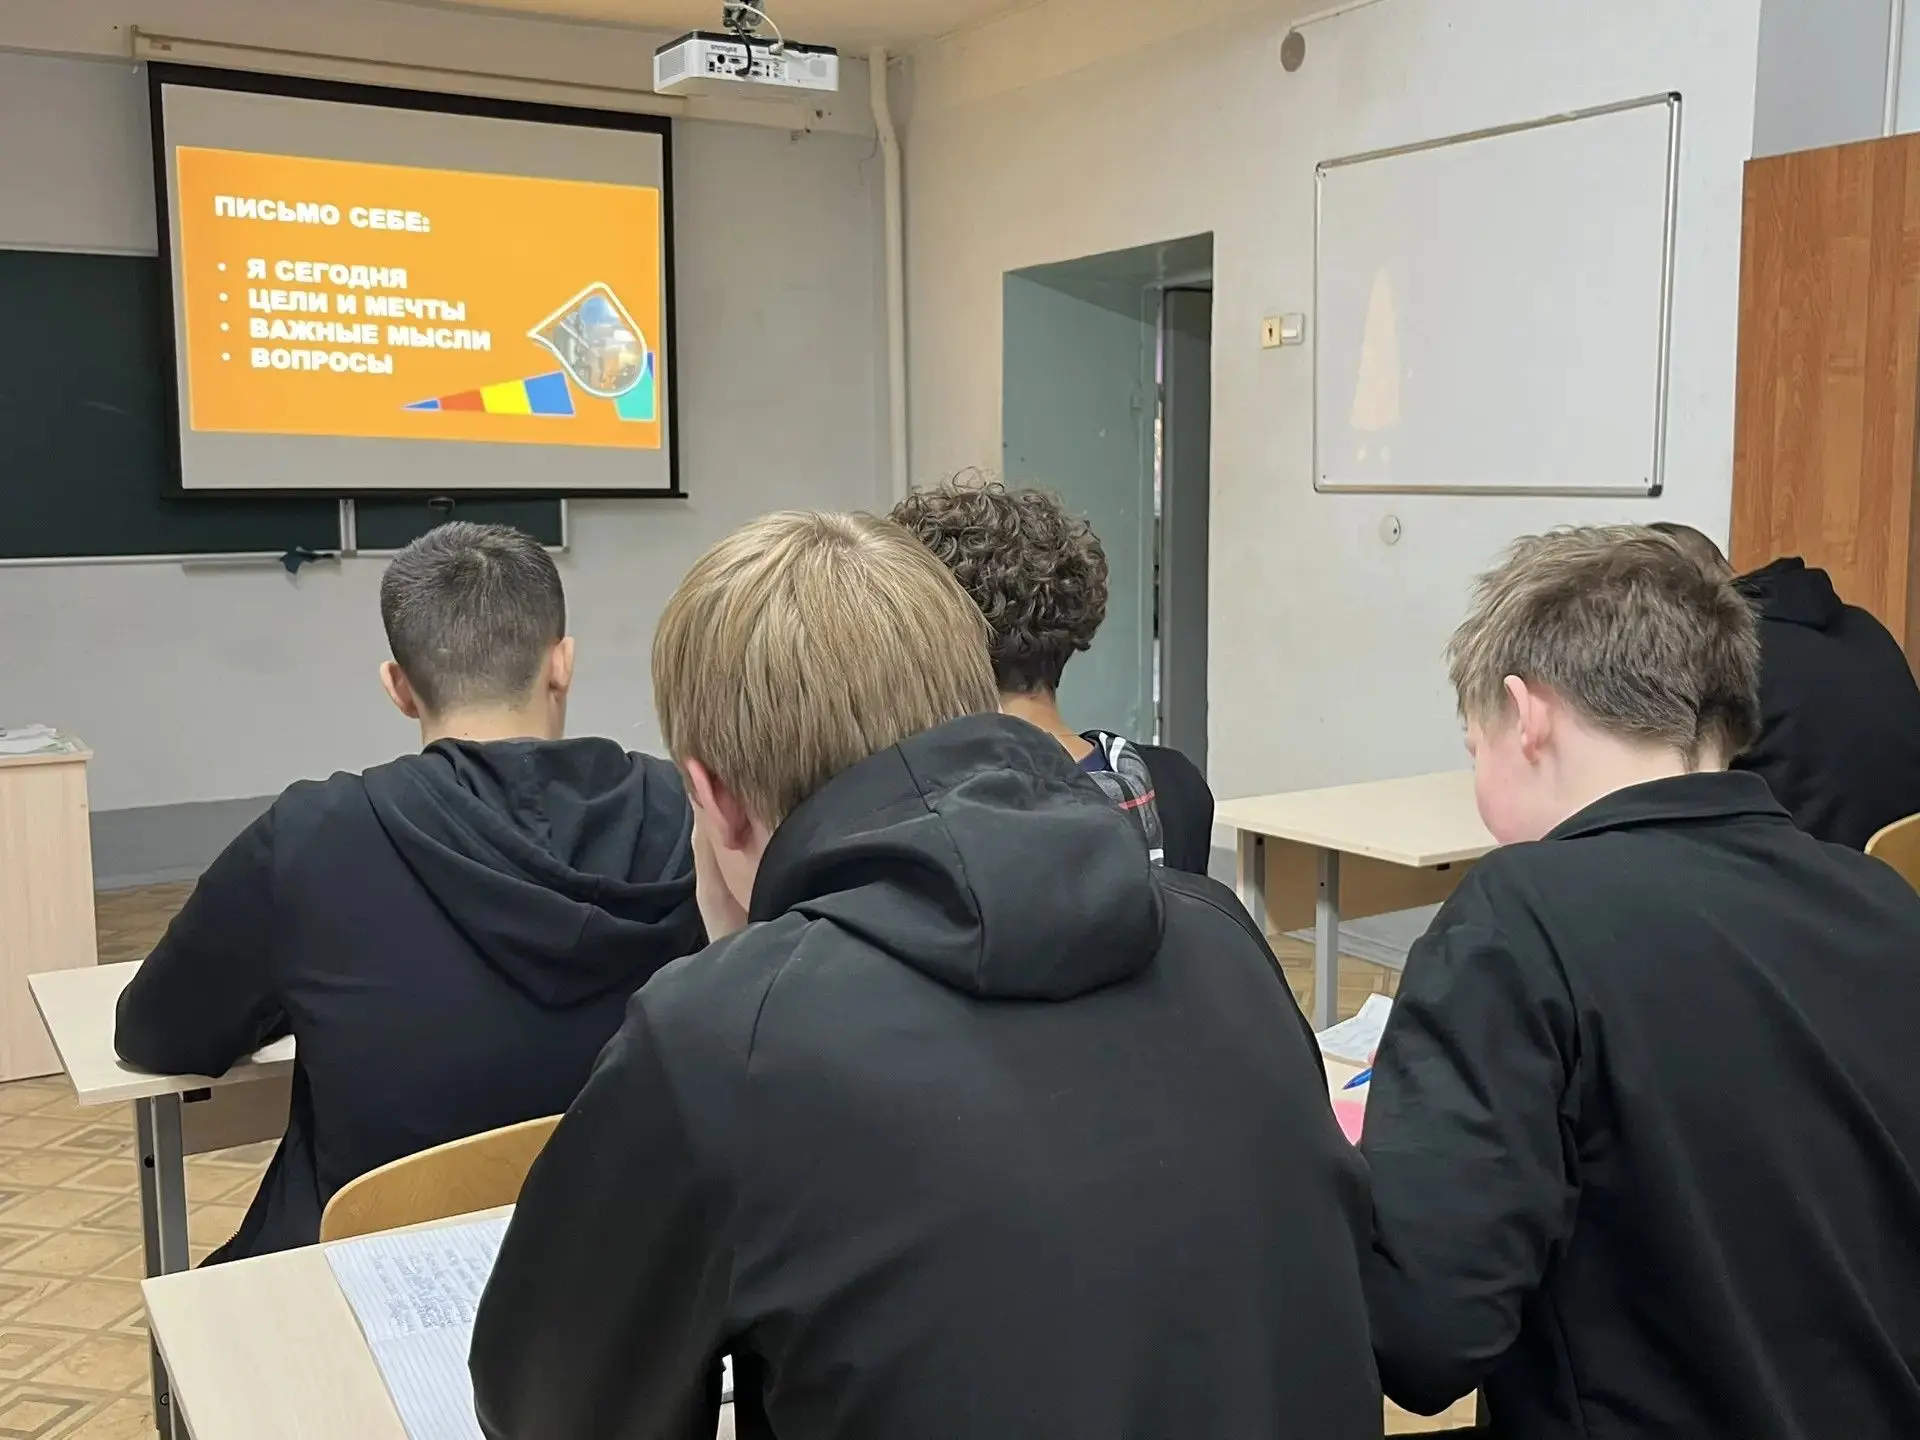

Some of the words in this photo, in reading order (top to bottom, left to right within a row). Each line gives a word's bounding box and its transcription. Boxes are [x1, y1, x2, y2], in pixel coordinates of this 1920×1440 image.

[214, 195, 340, 225] ПИСЬМО
[349, 207, 431, 232] СЕБЕ:
[247, 258, 266, 279] Я
[275, 260, 407, 289] СЕГОДНЯ
[249, 288, 328, 313] ЦЕЛИ
[337, 294, 357, 315] И
[364, 296, 466, 321] МЕЧТЫ
[250, 317, 379, 345] ВАЖНЫЕ
[387, 325, 491, 351] МЫСЛИ
[251, 348, 393, 374] ВОПРОСЫ
